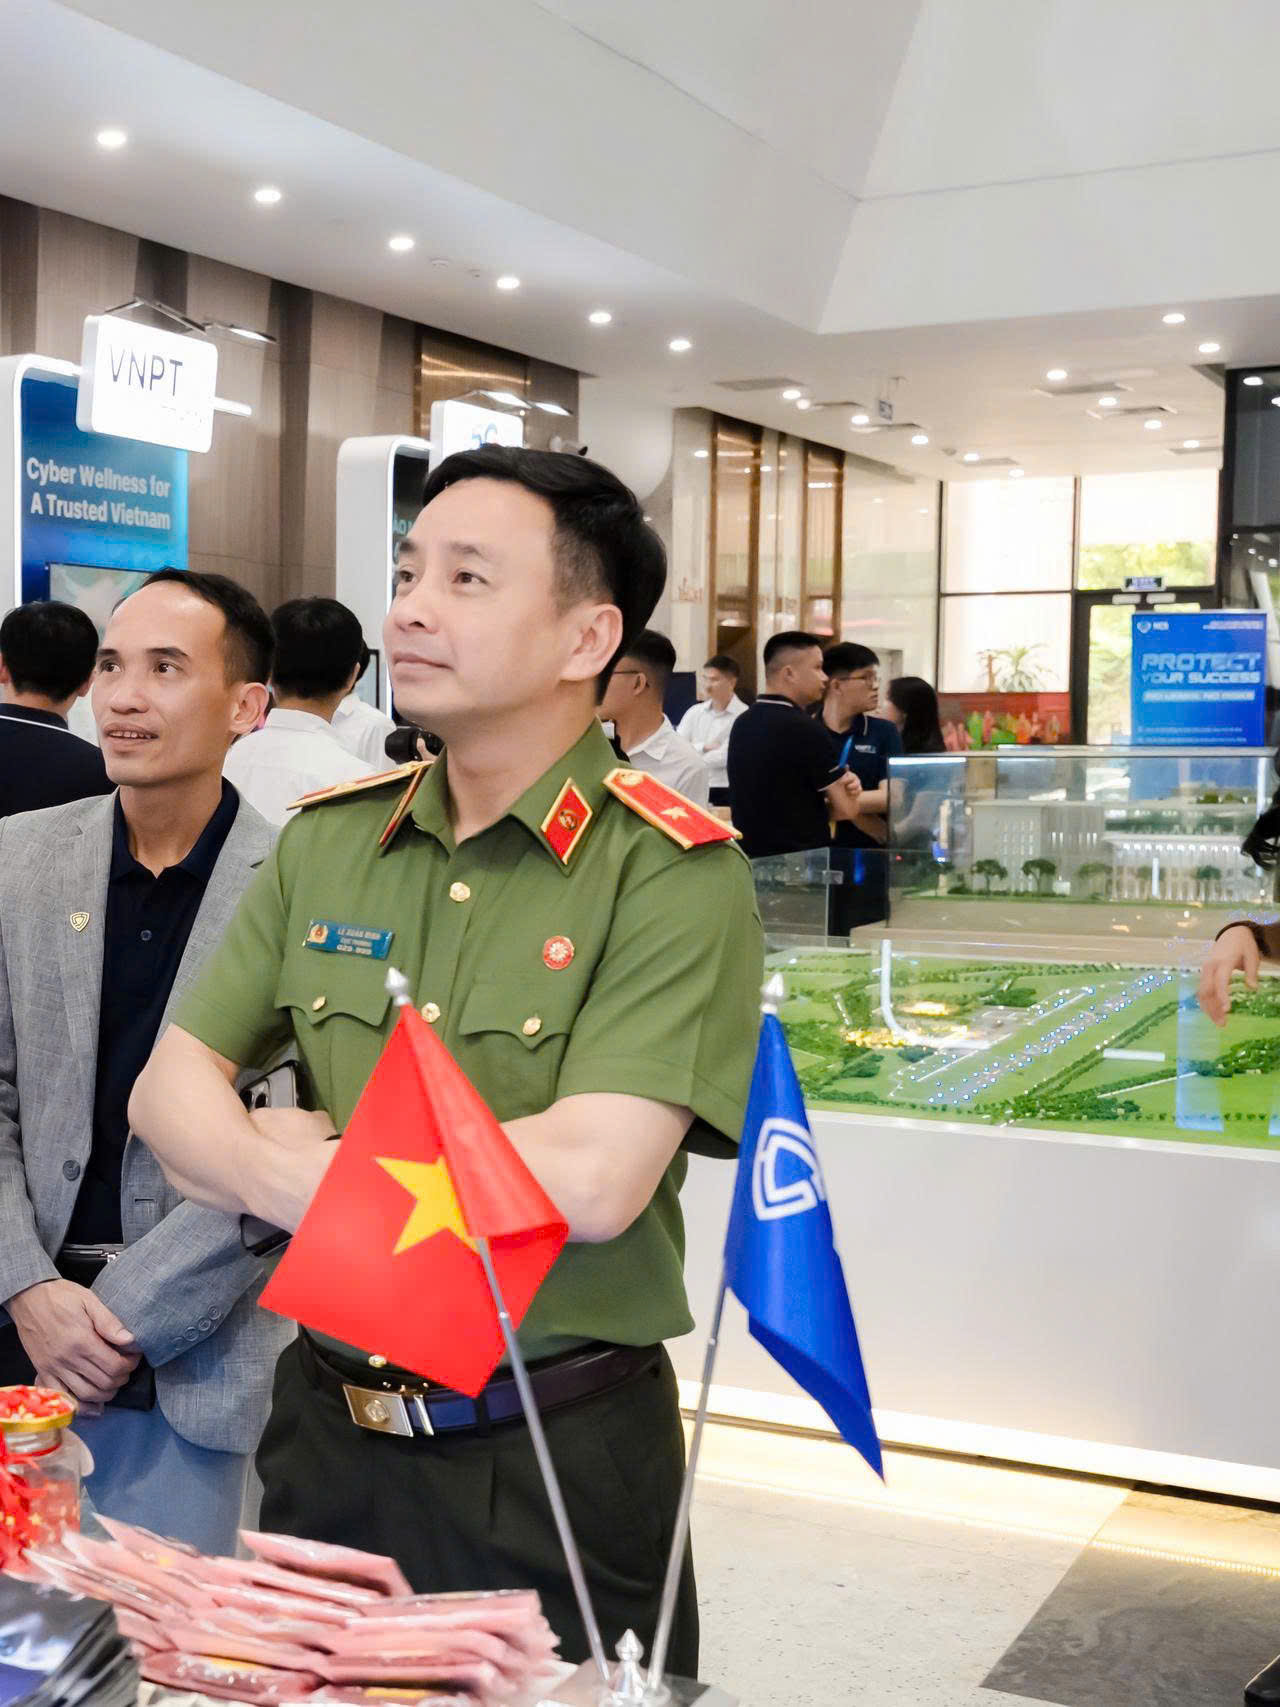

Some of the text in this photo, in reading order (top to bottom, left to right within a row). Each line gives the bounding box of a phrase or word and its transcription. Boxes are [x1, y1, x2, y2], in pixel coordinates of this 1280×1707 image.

[109, 344, 183, 397] VNPT
[26, 457, 170, 498] Cyber Wellness for
[30, 492, 170, 530] A Trusted Vietnam
[1142, 653, 1261, 671] PROTECT
[1142, 671, 1260, 684] YOUR SUCCESS
